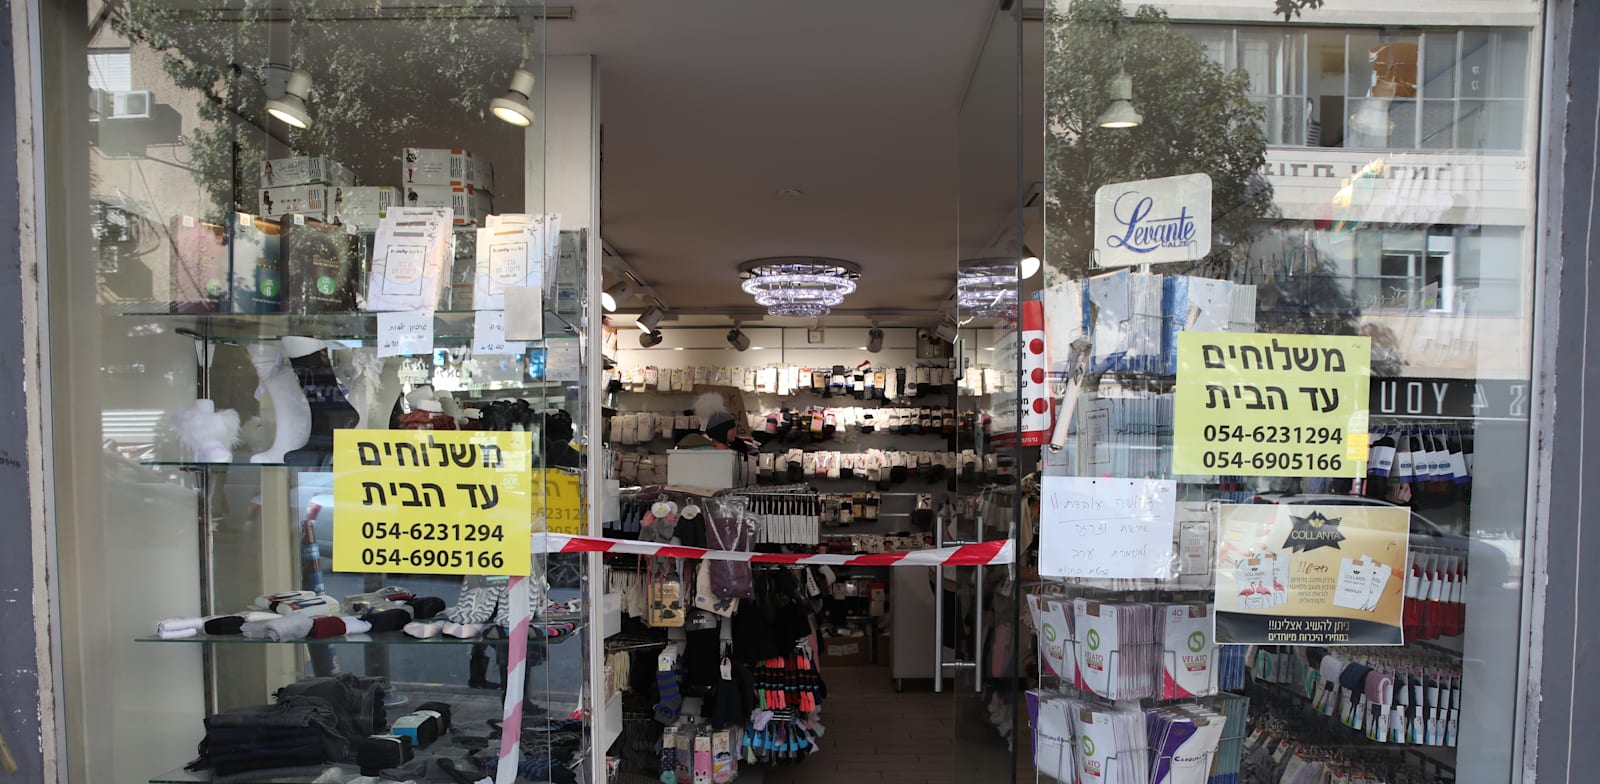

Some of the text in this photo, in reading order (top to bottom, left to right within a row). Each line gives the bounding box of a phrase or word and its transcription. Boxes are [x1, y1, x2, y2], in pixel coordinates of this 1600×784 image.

[1106, 190, 1196, 253] Levante
[1201, 338, 1346, 373] משלוחים
[1205, 384, 1339, 413] עד הבית
[1203, 424, 1343, 445] 054-6231294
[356, 434, 505, 469] משלוחים
[1202, 450, 1342, 472] 054-6905166
[361, 481, 500, 510] עד הבית
[361, 521, 504, 542] 054-6231294
[1290, 530, 1341, 541] COLLANTA
[361, 548, 504, 569] 054-6905166
[1268, 618, 1350, 633] ניתן להשיג אצלינו!!
[1268, 632, 1349, 642] במחירי היכרות מיוחדים
[1182, 654, 1208, 663] VELATO
